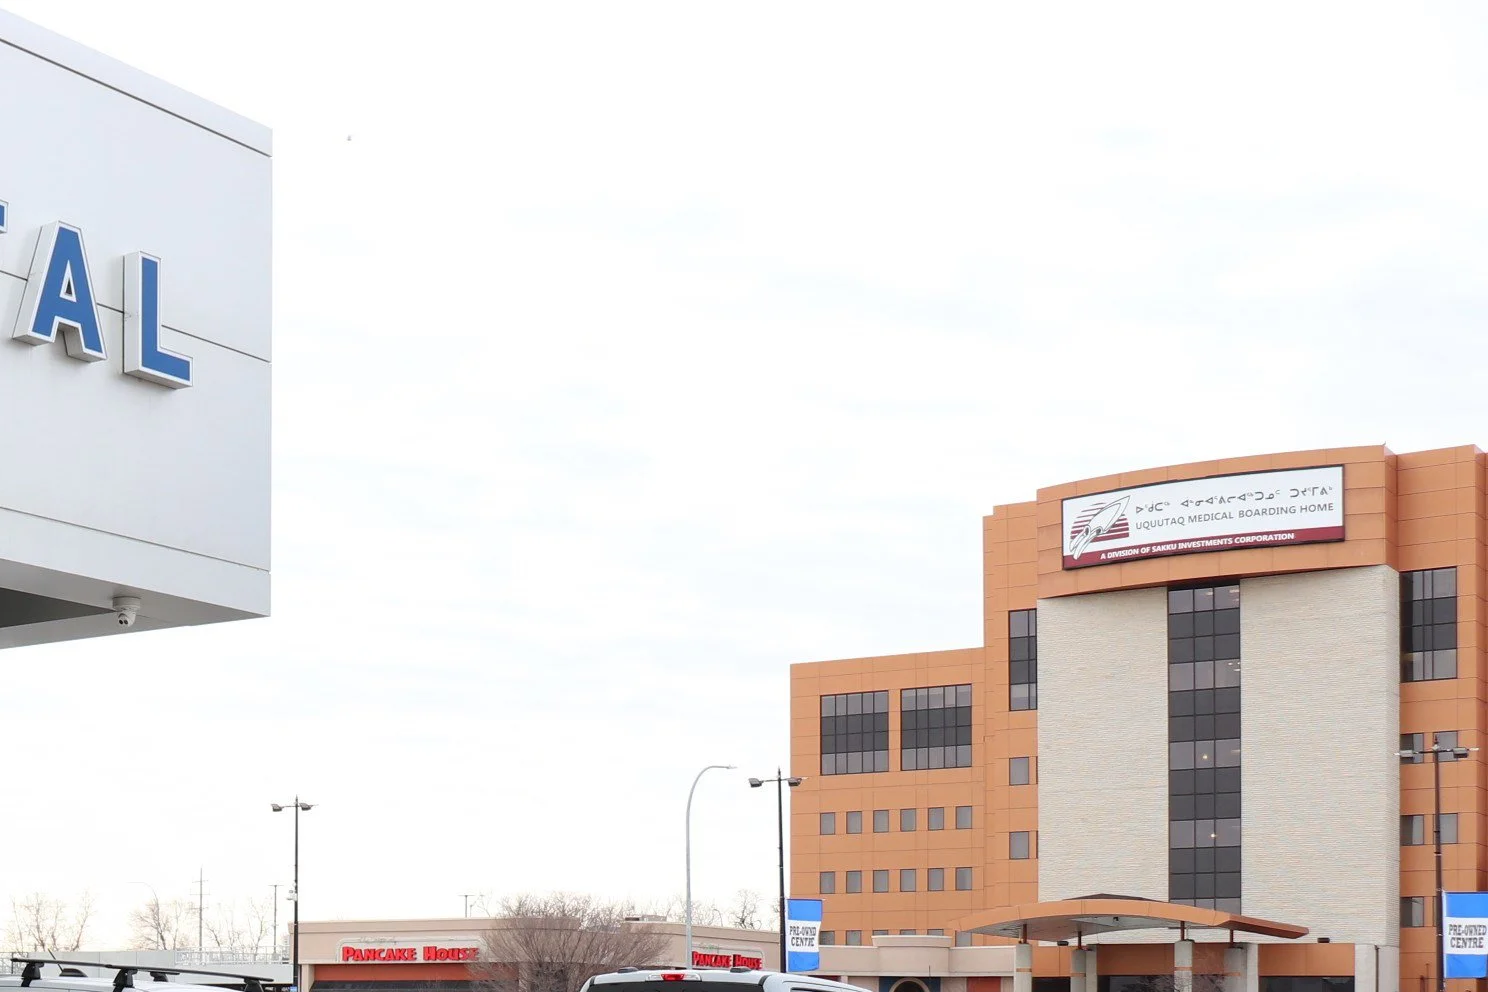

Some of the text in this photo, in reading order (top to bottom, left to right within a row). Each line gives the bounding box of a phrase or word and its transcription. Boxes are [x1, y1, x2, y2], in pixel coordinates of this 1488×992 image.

[1135, 502, 1334, 530] UQUUTAQ MEDICAL BOARDING HOME
[1107, 548, 1139, 559] DIVISION
[1140, 546, 1151, 554] OF
[1152, 543, 1177, 552] SAKKU
[1178, 537, 1233, 549] INVESTMENTS
[1234, 533, 1295, 544] CORPORATION
[1448, 924, 1487, 936] PRE-OWNED
[1450, 937, 1484, 949] CENTRE
[342, 945, 479, 962] PANCAKE HOUSE
[692, 951, 762, 970] PANCAKE HOUSE
